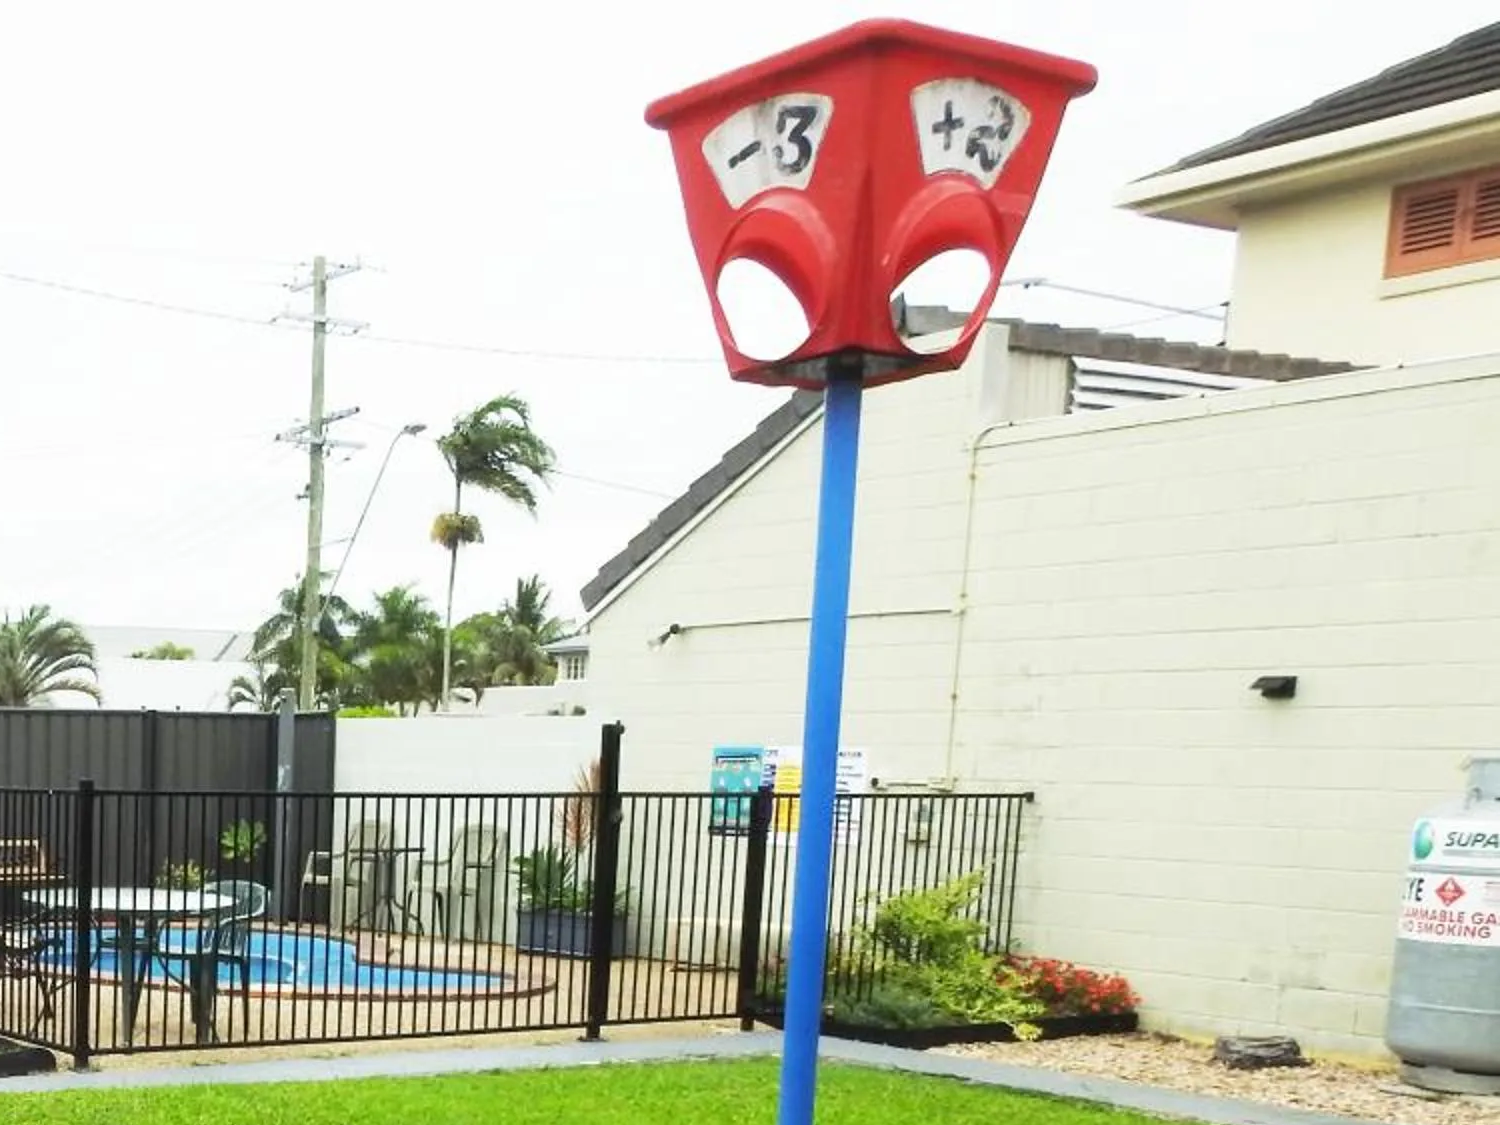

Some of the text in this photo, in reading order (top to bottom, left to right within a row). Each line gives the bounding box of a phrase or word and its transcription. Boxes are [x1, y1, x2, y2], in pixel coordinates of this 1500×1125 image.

[1443, 830, 1500, 849] SUPA
[1470, 911, 1500, 926] GA
[1416, 920, 1492, 939] SMOKING
